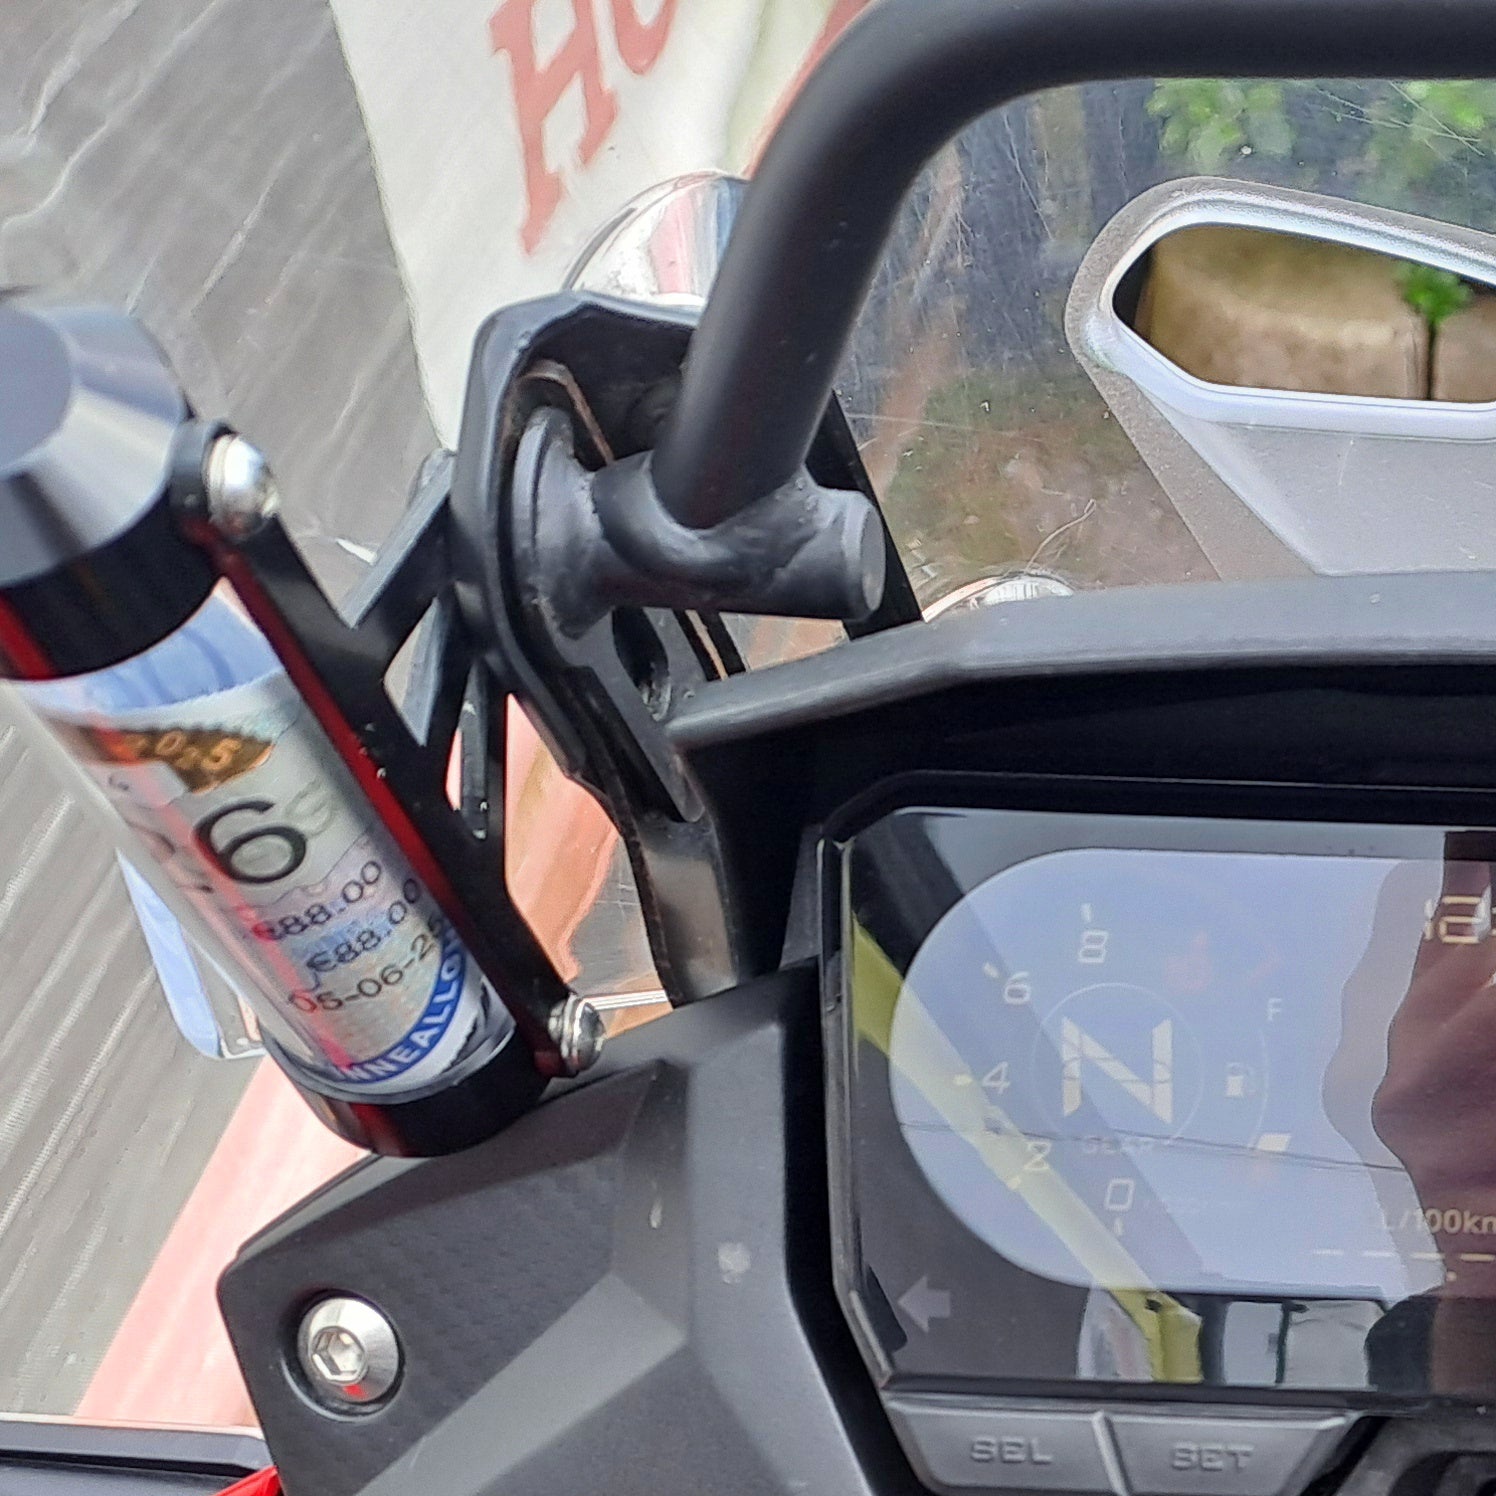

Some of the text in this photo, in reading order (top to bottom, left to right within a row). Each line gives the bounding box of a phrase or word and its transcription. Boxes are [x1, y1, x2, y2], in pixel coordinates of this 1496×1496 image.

[192, 800, 307, 885] 6
[1077, 930, 1110, 963] 8
[1003, 971, 1032, 1004] 6
[981, 1061, 1014, 1093] 4
[1061, 1017, 1173, 1124] N
[971, 1435, 1053, 1464] SEL
[1171, 1441, 1255, 1471] SET
